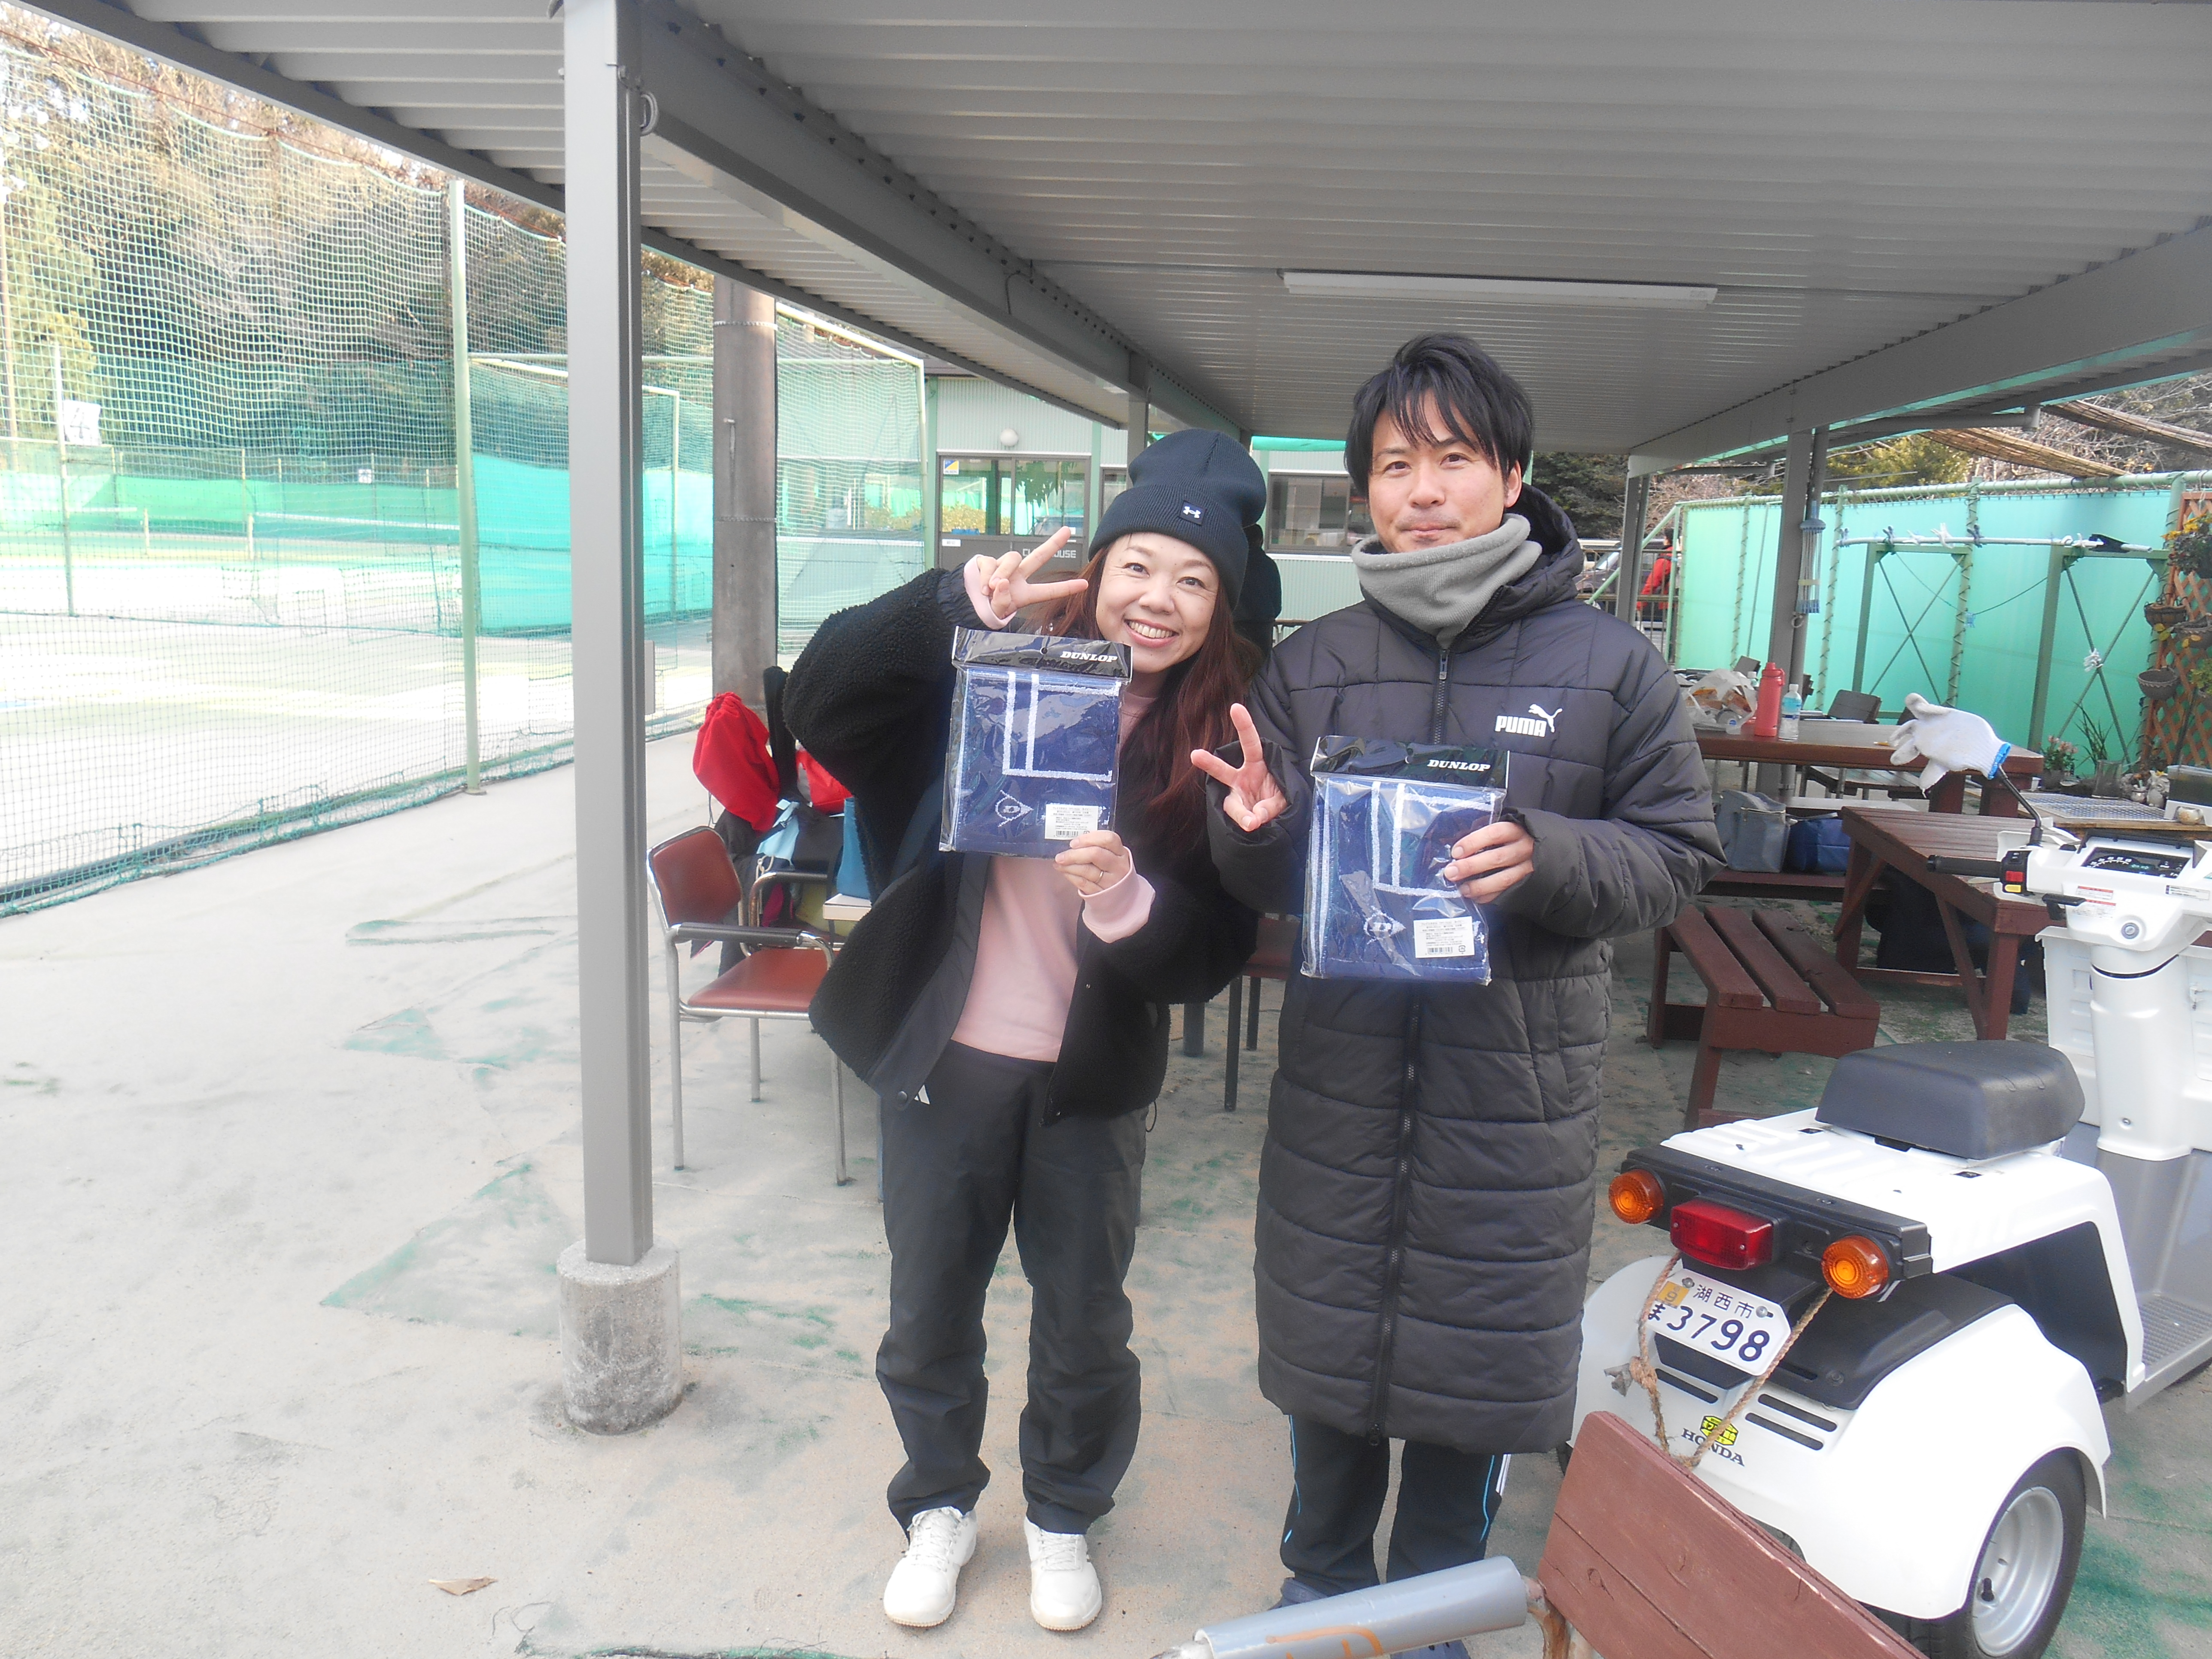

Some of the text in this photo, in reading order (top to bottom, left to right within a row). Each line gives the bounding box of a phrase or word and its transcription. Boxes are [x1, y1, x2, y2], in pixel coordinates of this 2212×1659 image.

[1060, 651, 1118, 662] DUNLOP
[1495, 715, 1547, 737] PUMA
[1427, 759, 1491, 772] DUNLOP
[1693, 1284, 1754, 1319] 湖西市
[1648, 1304, 1770, 1361] ま 3798
